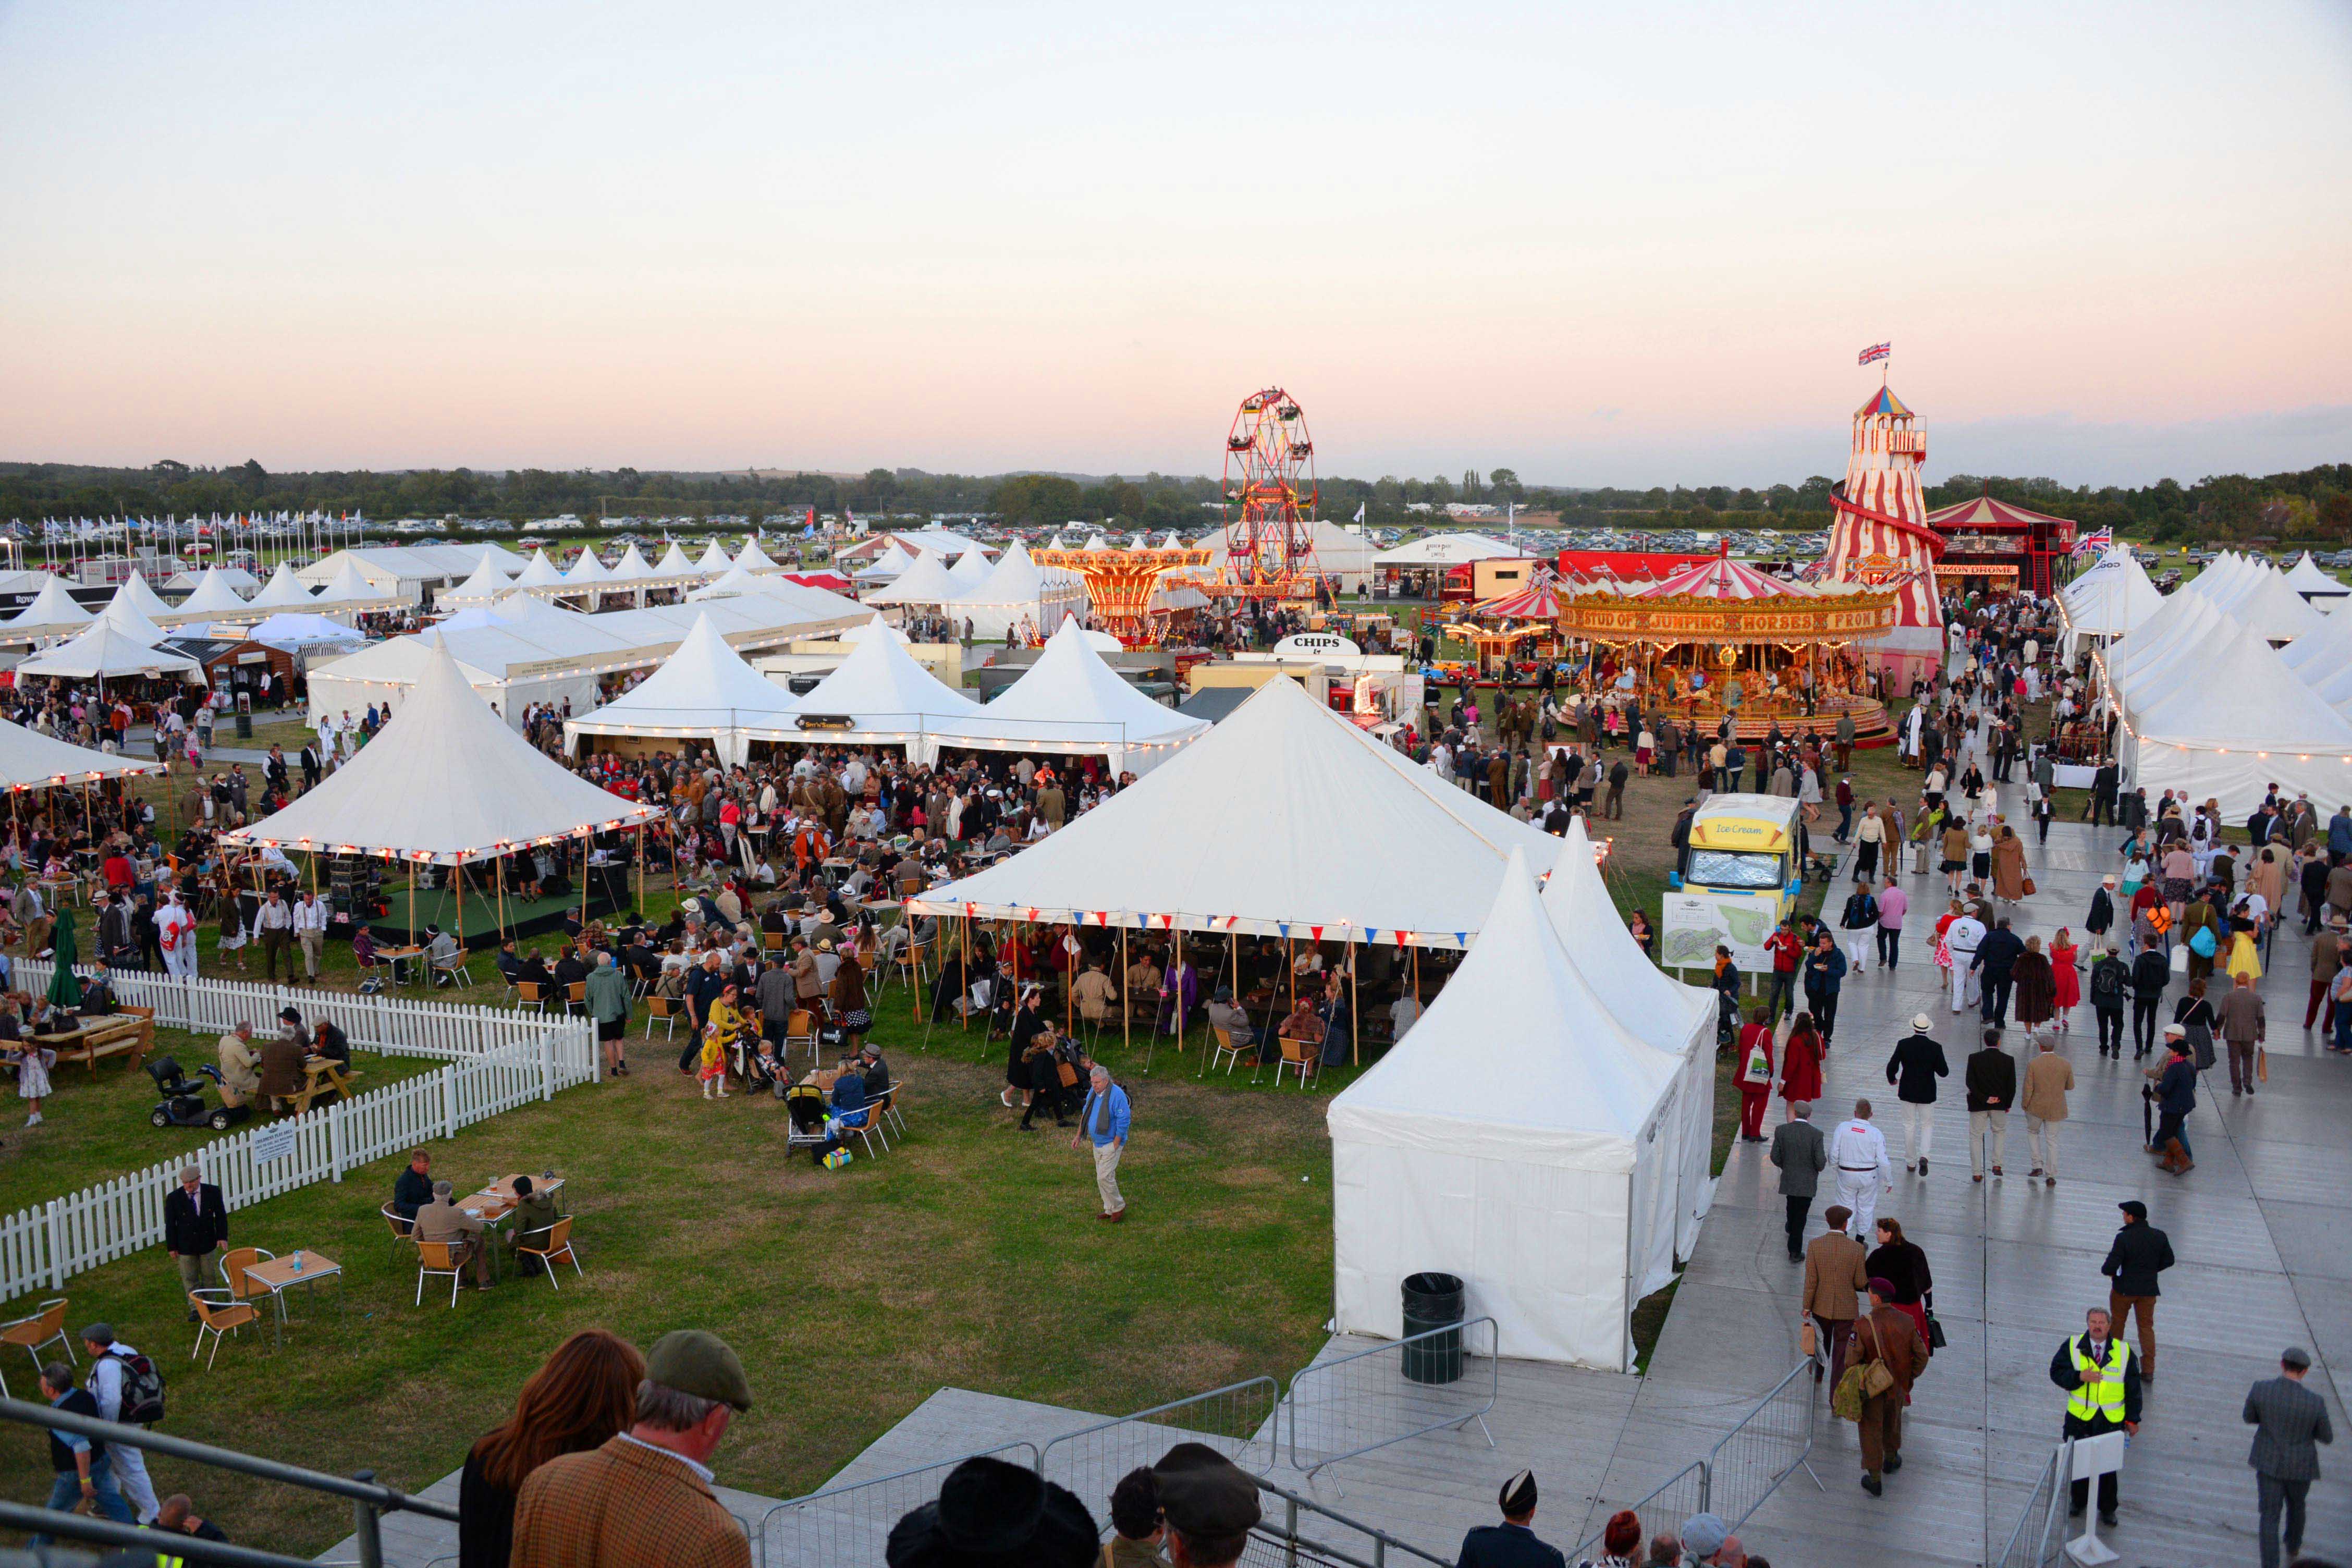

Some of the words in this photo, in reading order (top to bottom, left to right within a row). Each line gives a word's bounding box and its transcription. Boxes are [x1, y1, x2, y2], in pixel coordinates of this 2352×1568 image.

[1585, 611, 1614, 626] STUD
[1617, 614, 1636, 626] OF
[1650, 612, 1723, 629] JUMPING
[1743, 615, 1812, 630] HORSES
[1834, 612, 1871, 628] FROM
[1294, 638, 1340, 647] CHIPS
[1716, 824, 1731, 833] Ice
[1732, 825, 1763, 835] Cream
